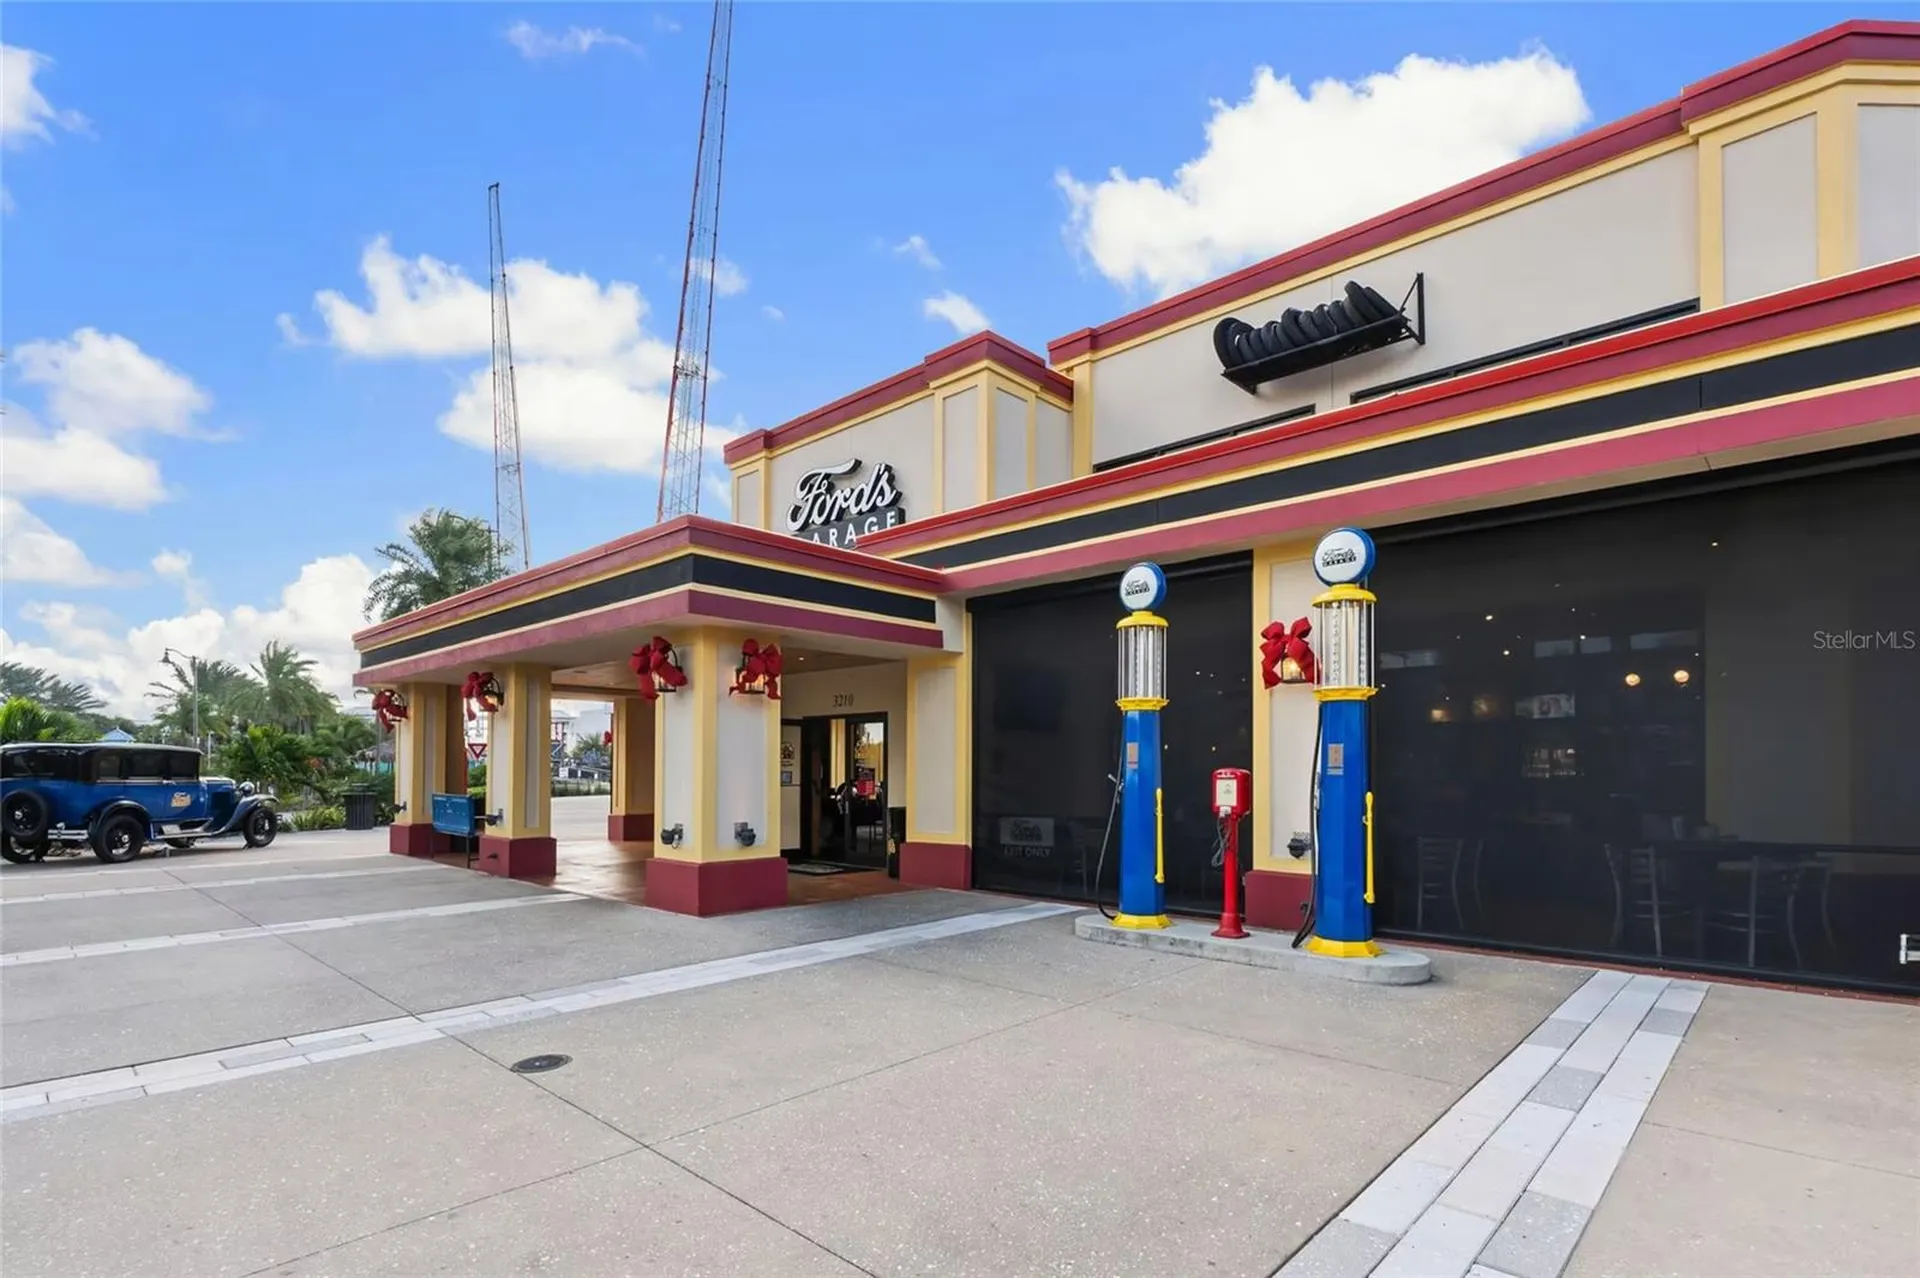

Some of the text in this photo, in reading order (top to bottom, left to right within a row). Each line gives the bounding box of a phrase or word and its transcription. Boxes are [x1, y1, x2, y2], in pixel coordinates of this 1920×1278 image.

[787, 458, 898, 532] Ford's
[811, 511, 896, 547] ARAGE
[833, 694, 854, 707] 3210
